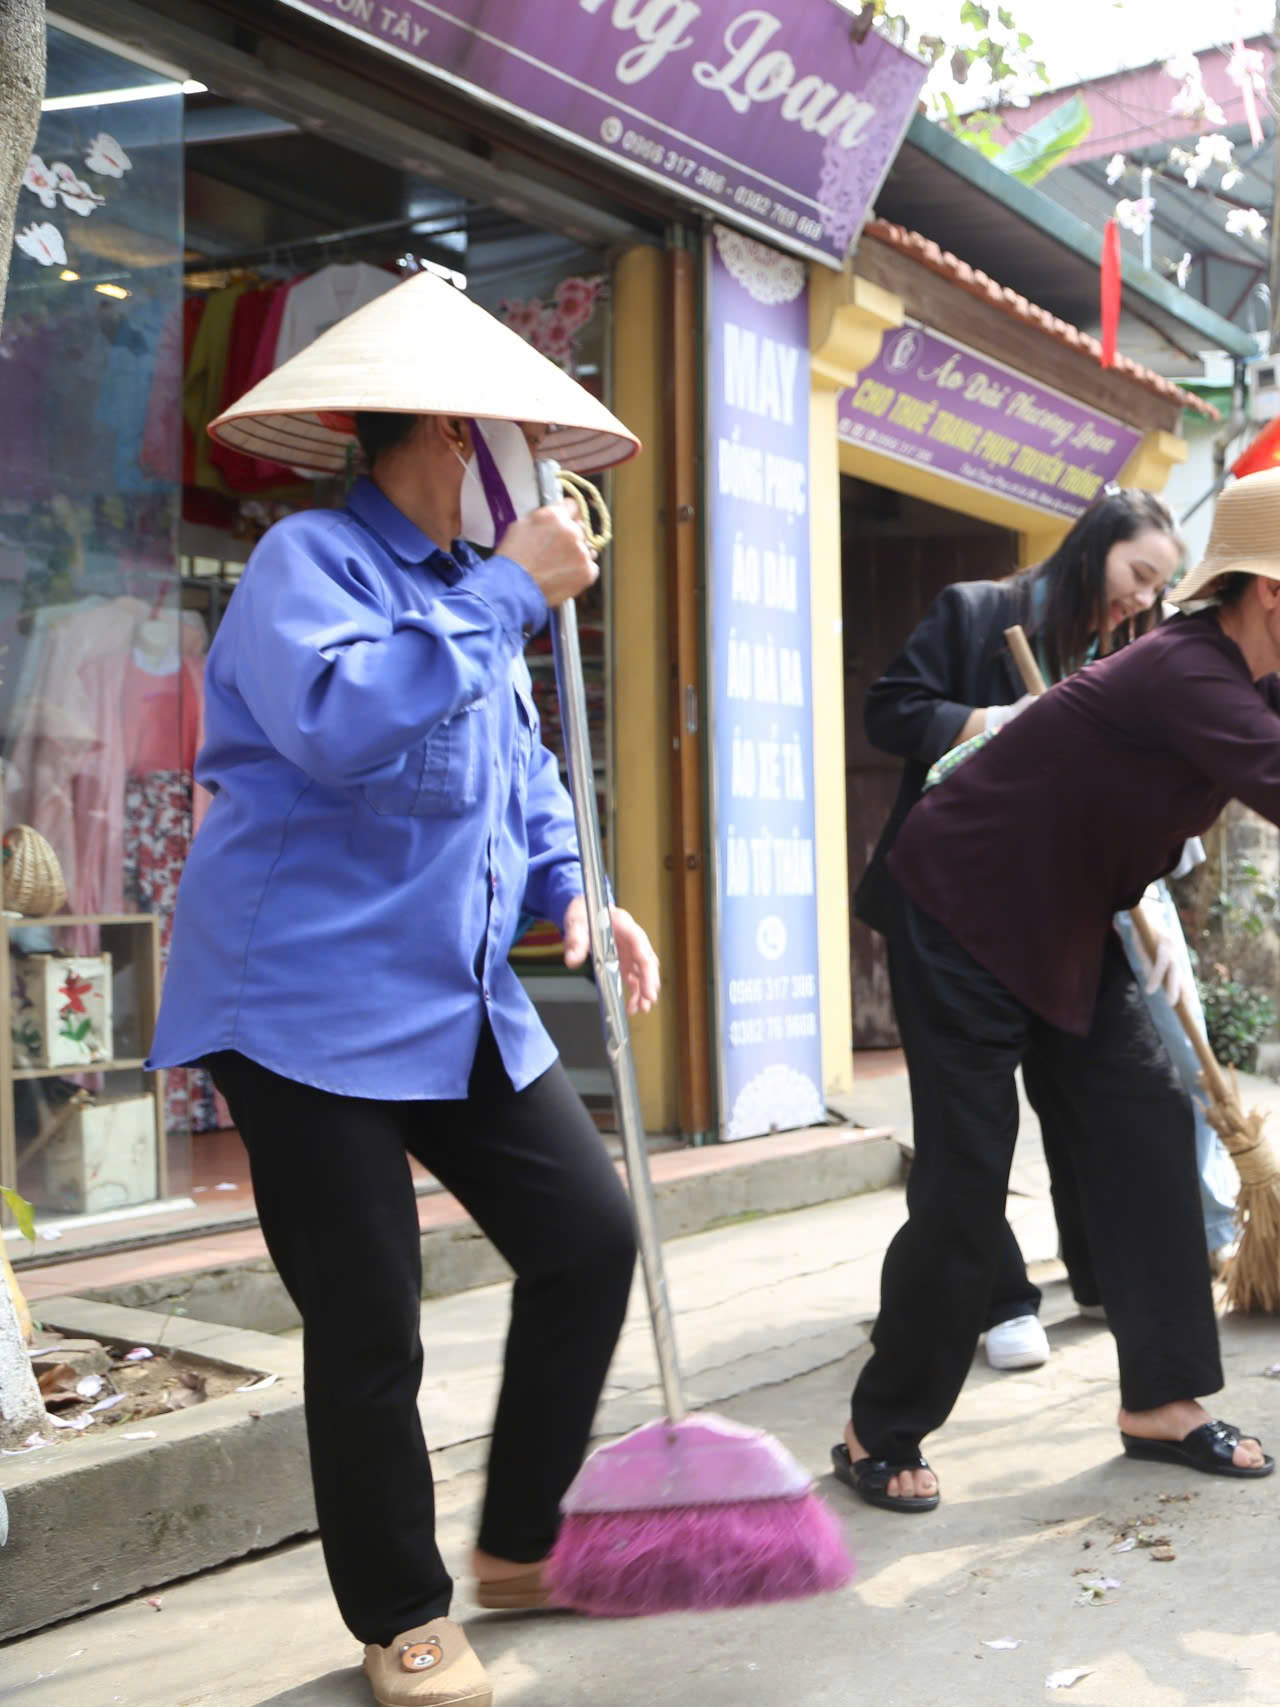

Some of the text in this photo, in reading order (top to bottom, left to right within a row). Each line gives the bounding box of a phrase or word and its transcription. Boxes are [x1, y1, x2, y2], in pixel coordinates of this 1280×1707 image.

[380, 7, 430, 47] TÂY
[692, 9, 876, 148] Loan
[723, 322, 799, 427] MAY
[851, 378, 897, 416] CHO
[927, 409, 984, 453] TRANG
[972, 429, 1021, 470] PHỤC
[731, 531, 797, 613] ÁO DÀI
[727, 626, 752, 701] ÁO
[731, 724, 756, 798] ÁO
[726, 823, 749, 897] ÁO
